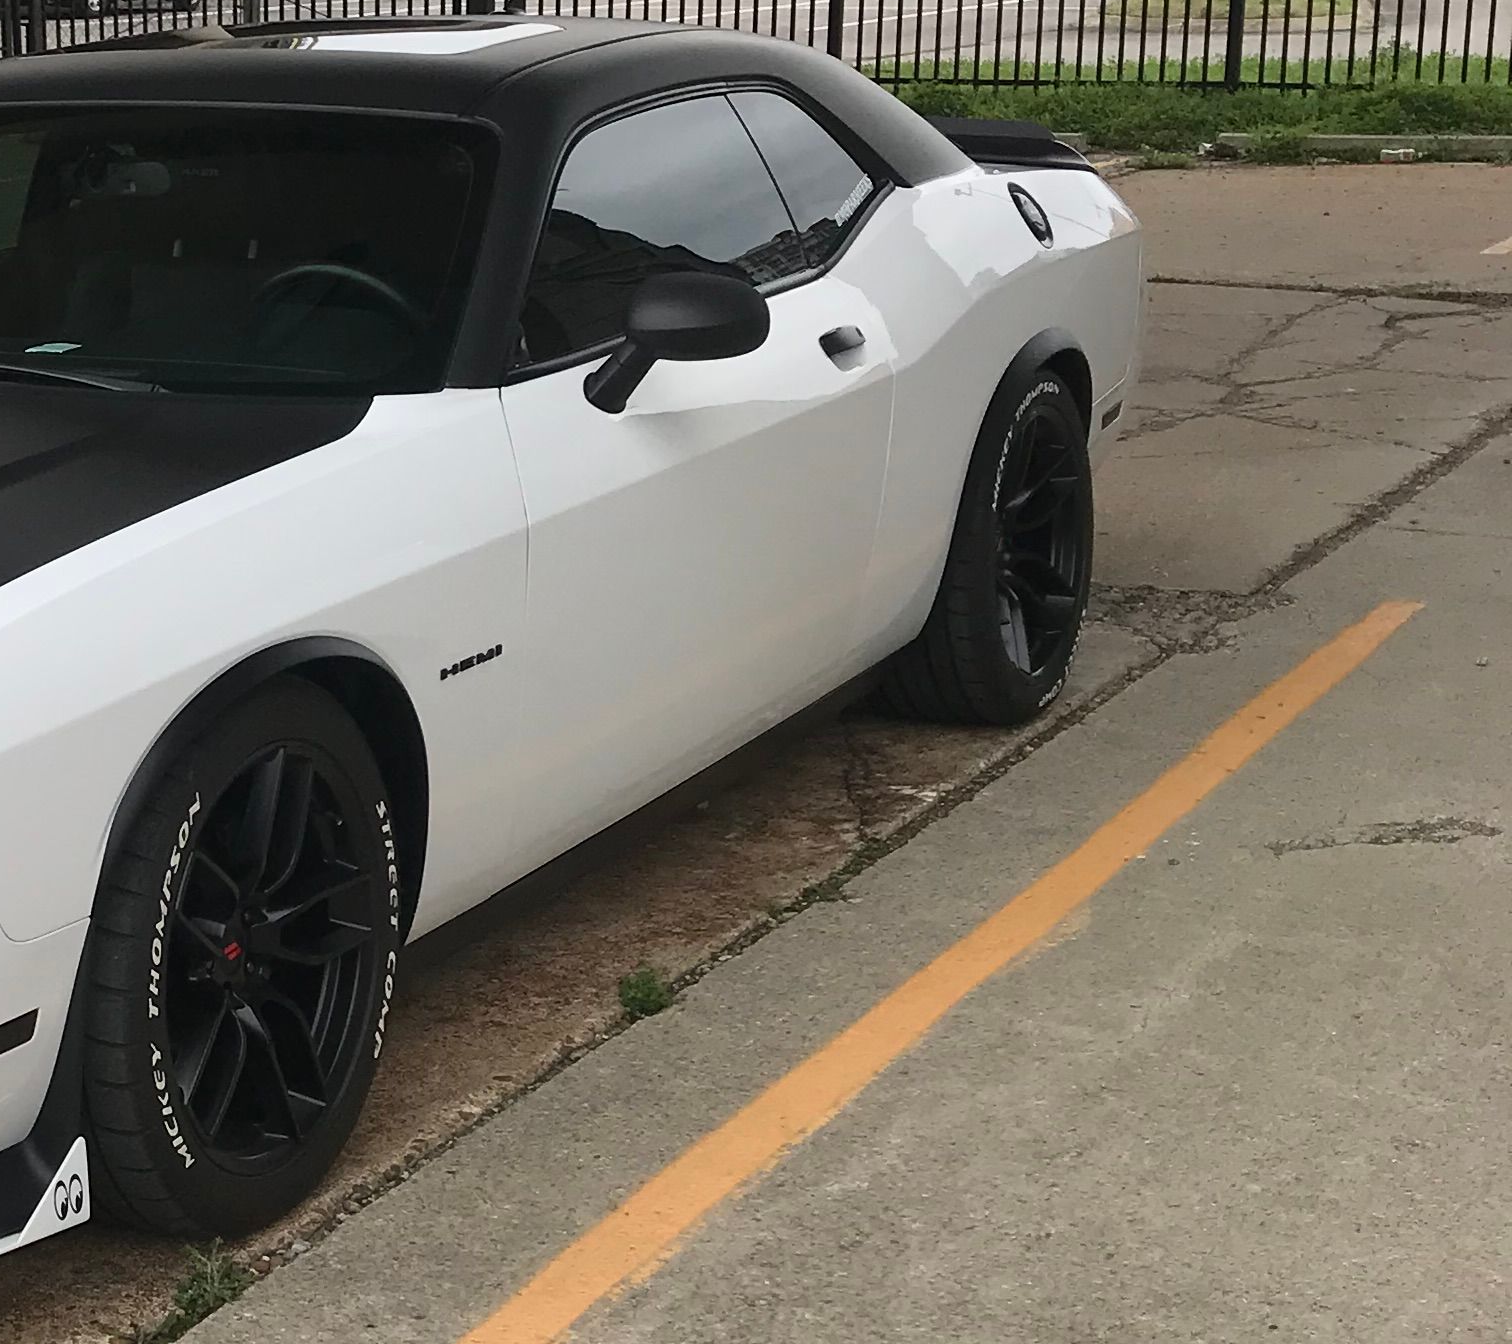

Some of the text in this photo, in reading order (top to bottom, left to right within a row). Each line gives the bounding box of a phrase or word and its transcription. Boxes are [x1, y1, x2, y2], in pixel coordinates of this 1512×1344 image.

[1015, 381, 1059, 422] THOMPSON
[440, 644, 502, 681] HEMI
[148, 791, 201, 1169] MICKEY THOMPSON
[373, 800, 399, 1059] STREET COMP
